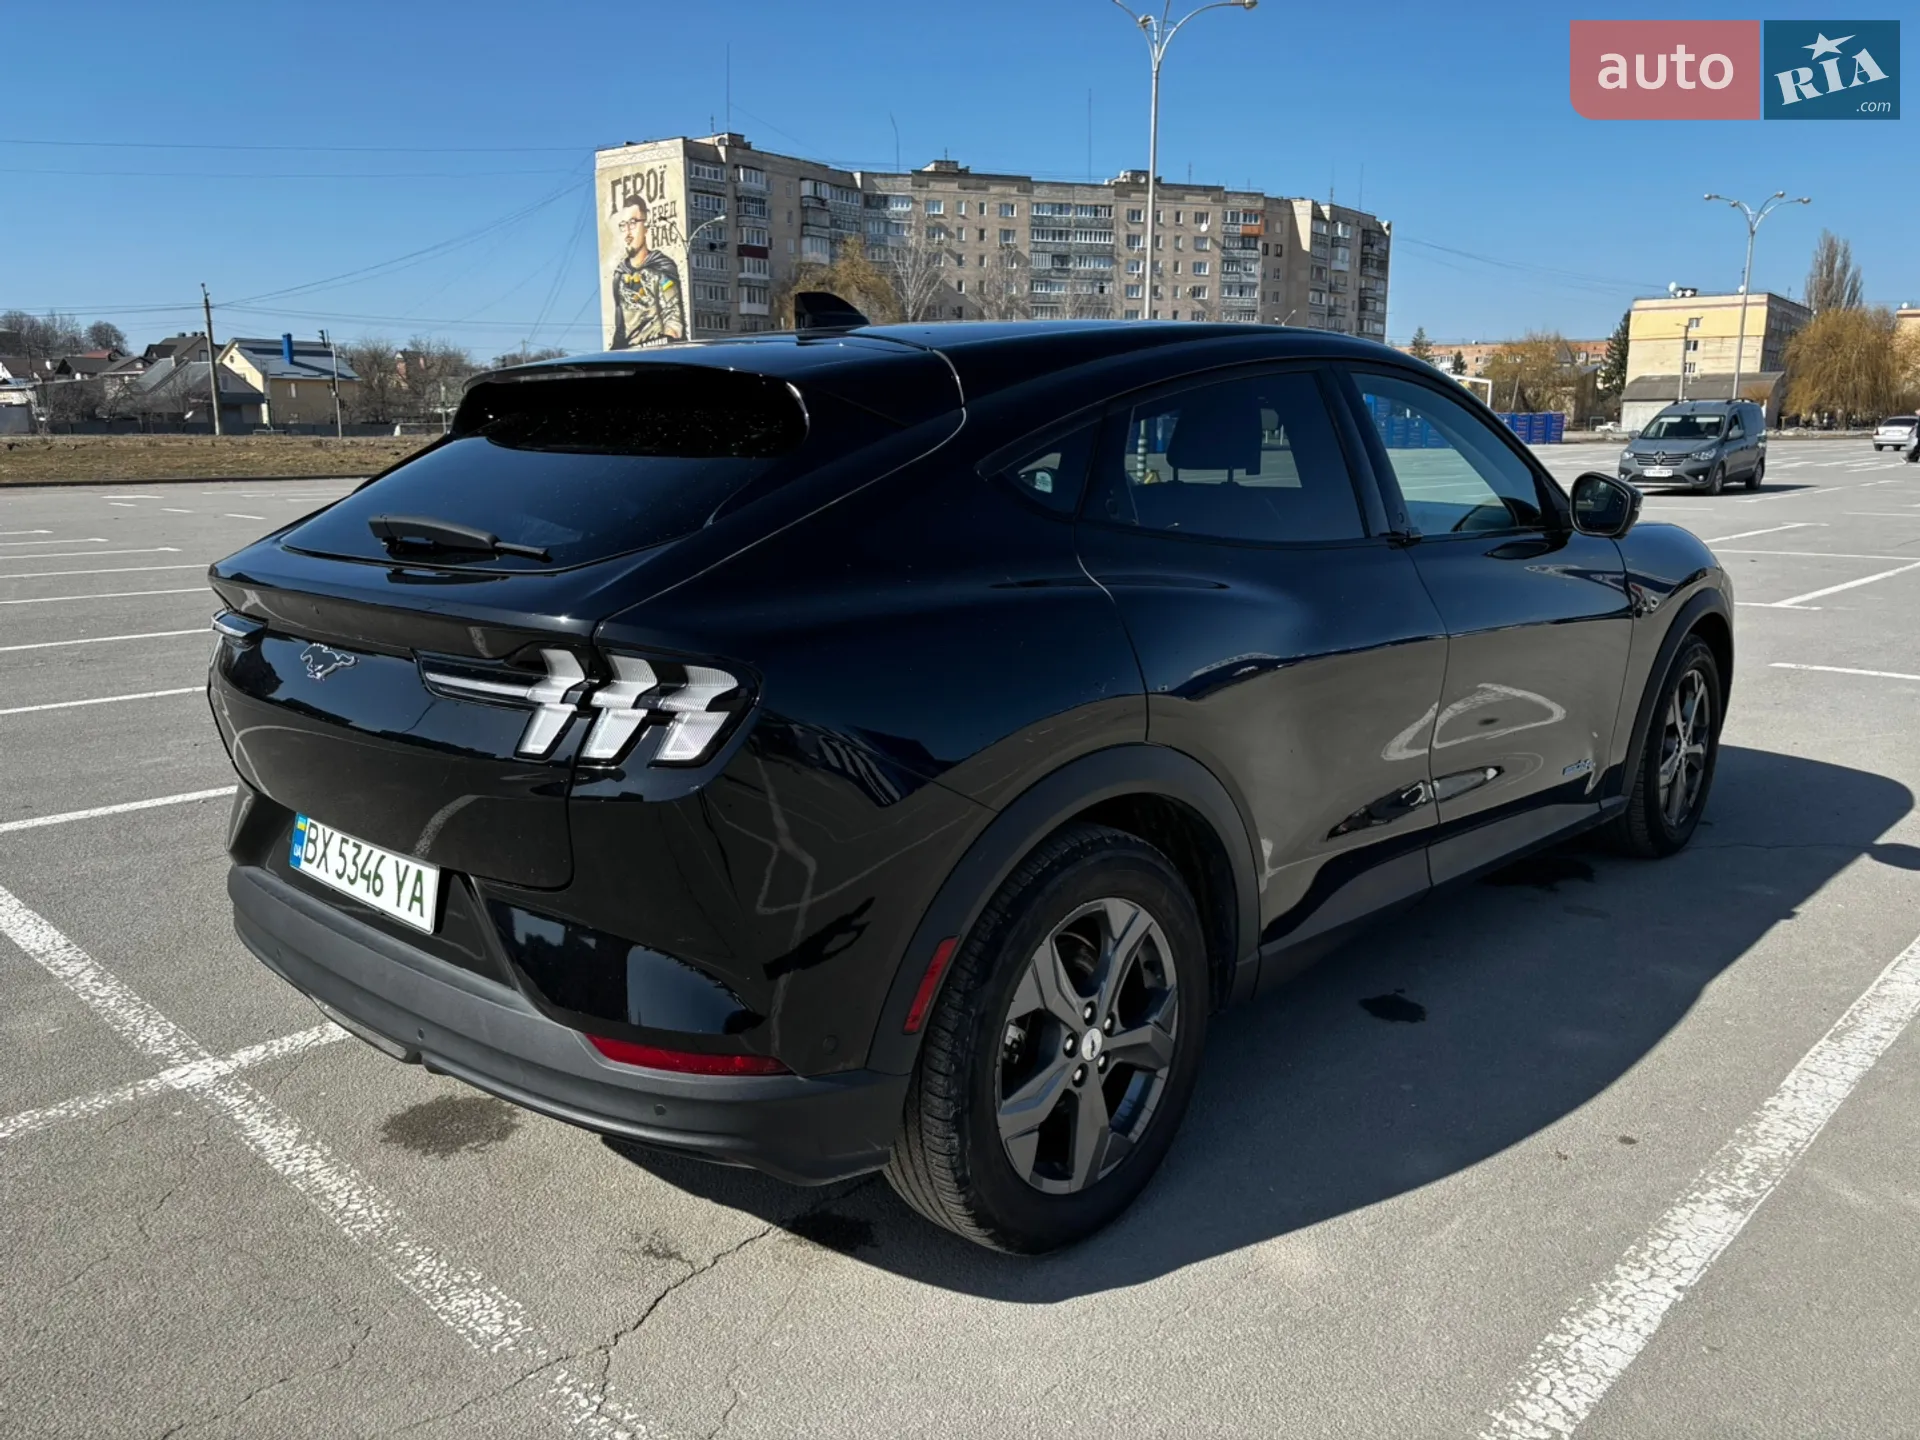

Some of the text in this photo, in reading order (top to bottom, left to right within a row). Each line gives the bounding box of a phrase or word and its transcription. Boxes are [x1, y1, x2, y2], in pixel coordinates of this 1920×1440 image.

[611, 164, 667, 215] ГЕРОЇ
[651, 221, 678, 249] НАС
[303, 821, 425, 918] BX 5346 YA
